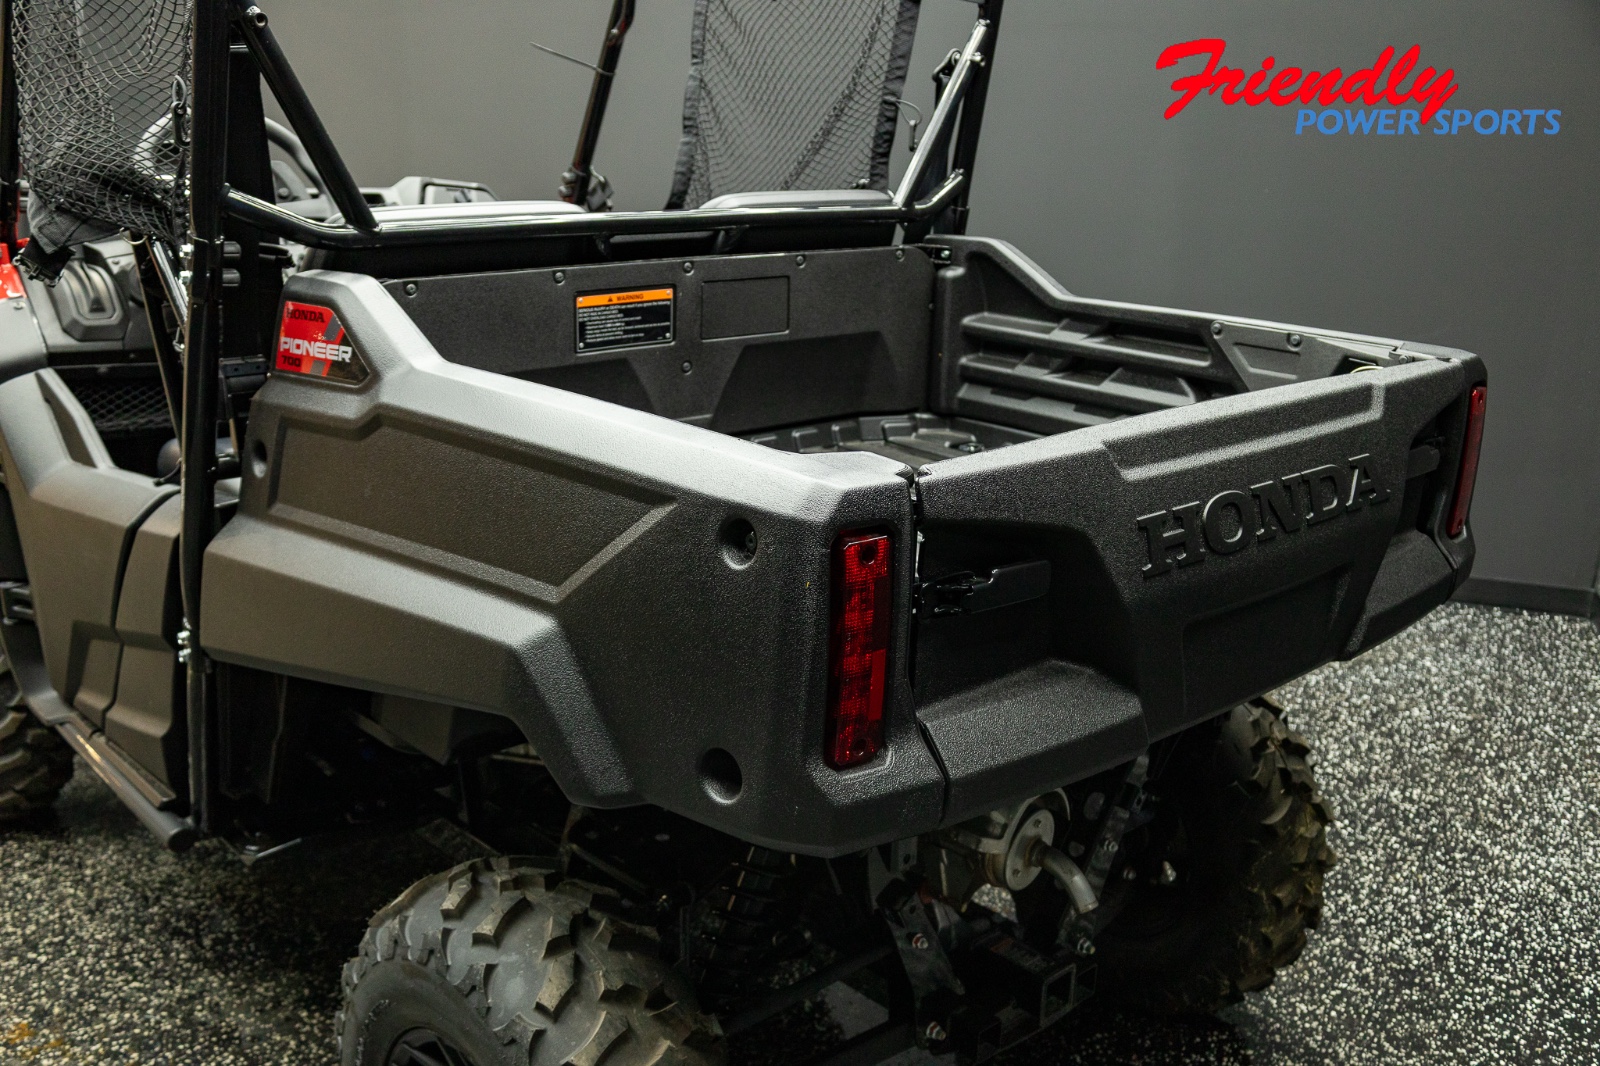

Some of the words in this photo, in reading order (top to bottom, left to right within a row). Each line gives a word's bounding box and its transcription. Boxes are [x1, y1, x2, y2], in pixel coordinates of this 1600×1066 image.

[616, 293, 644, 302] WARNING
[286, 308, 325, 323] HONDA
[281, 337, 353, 363] PIONEER
[281, 355, 302, 367] 700
[1137, 453, 1391, 579] HONDA
